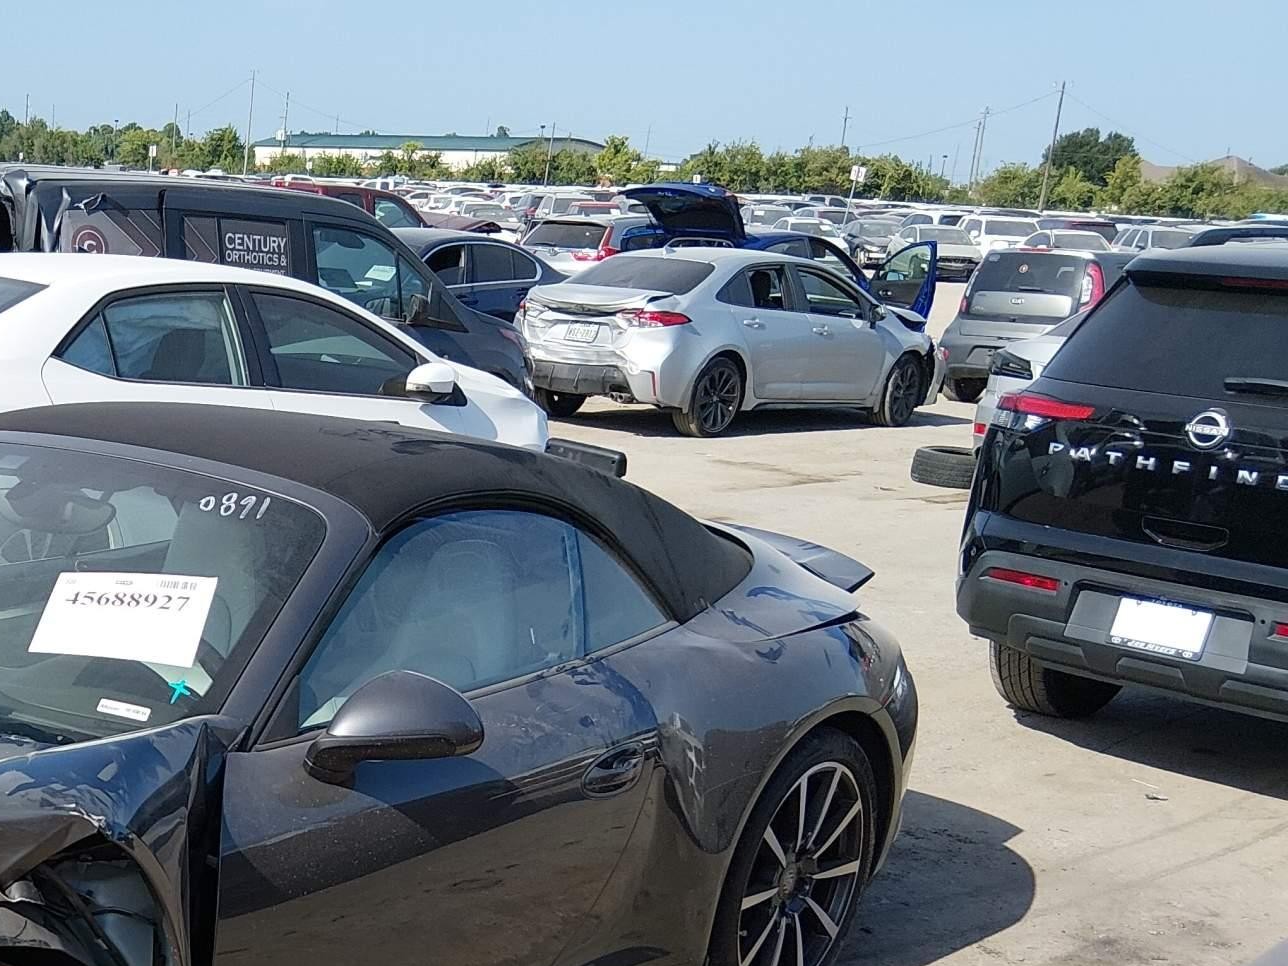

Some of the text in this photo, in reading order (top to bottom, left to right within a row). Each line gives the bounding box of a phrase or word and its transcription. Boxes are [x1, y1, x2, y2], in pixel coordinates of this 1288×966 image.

[225, 232, 287, 253] CENTURY
[225, 250, 287, 266] ORTHOTICS &
[1184, 422, 1230, 437] NISSAN
[198, 492, 271, 520] 0891
[65, 591, 192, 612] 45688927
